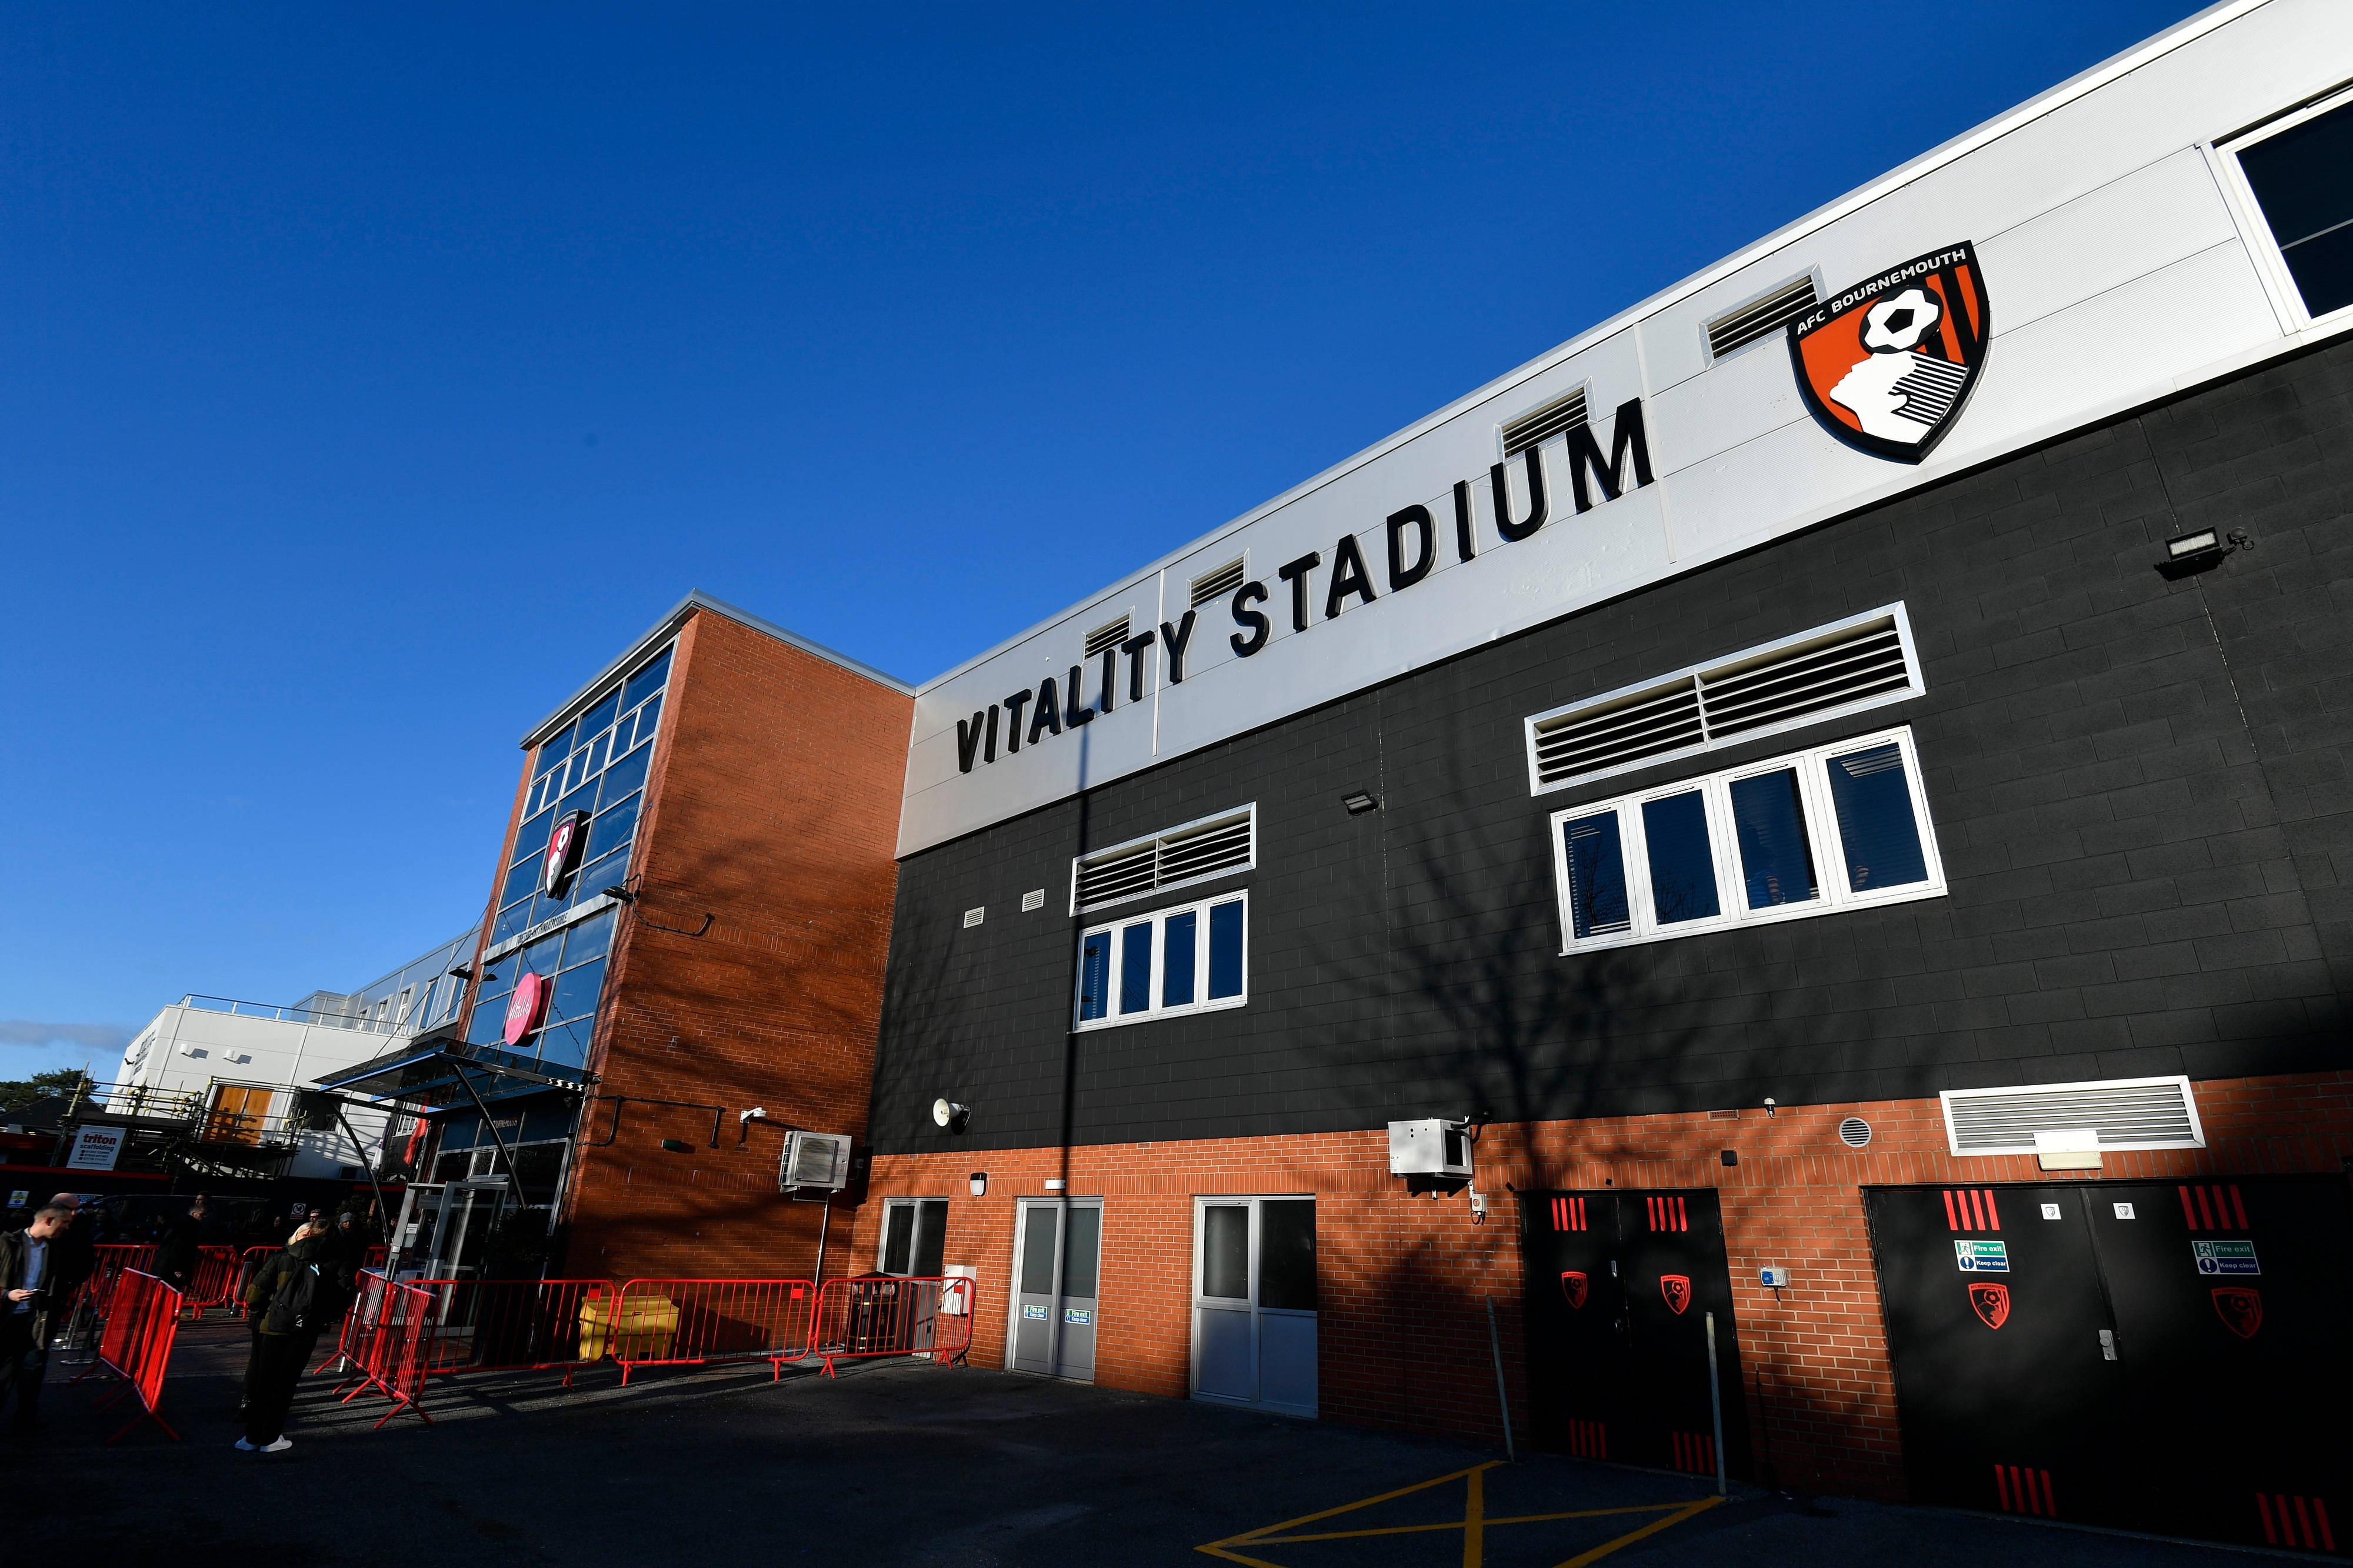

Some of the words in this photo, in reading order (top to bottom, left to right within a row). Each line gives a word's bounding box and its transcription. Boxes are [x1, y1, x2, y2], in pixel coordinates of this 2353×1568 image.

[1797, 310, 1825, 335] AFC
[1831, 249, 1967, 313] BOURNEMOUTH
[956, 610, 1197, 773] VITALITY
[1229, 396, 1655, 658] STADIUM
[83, 1133, 117, 1145] triton
